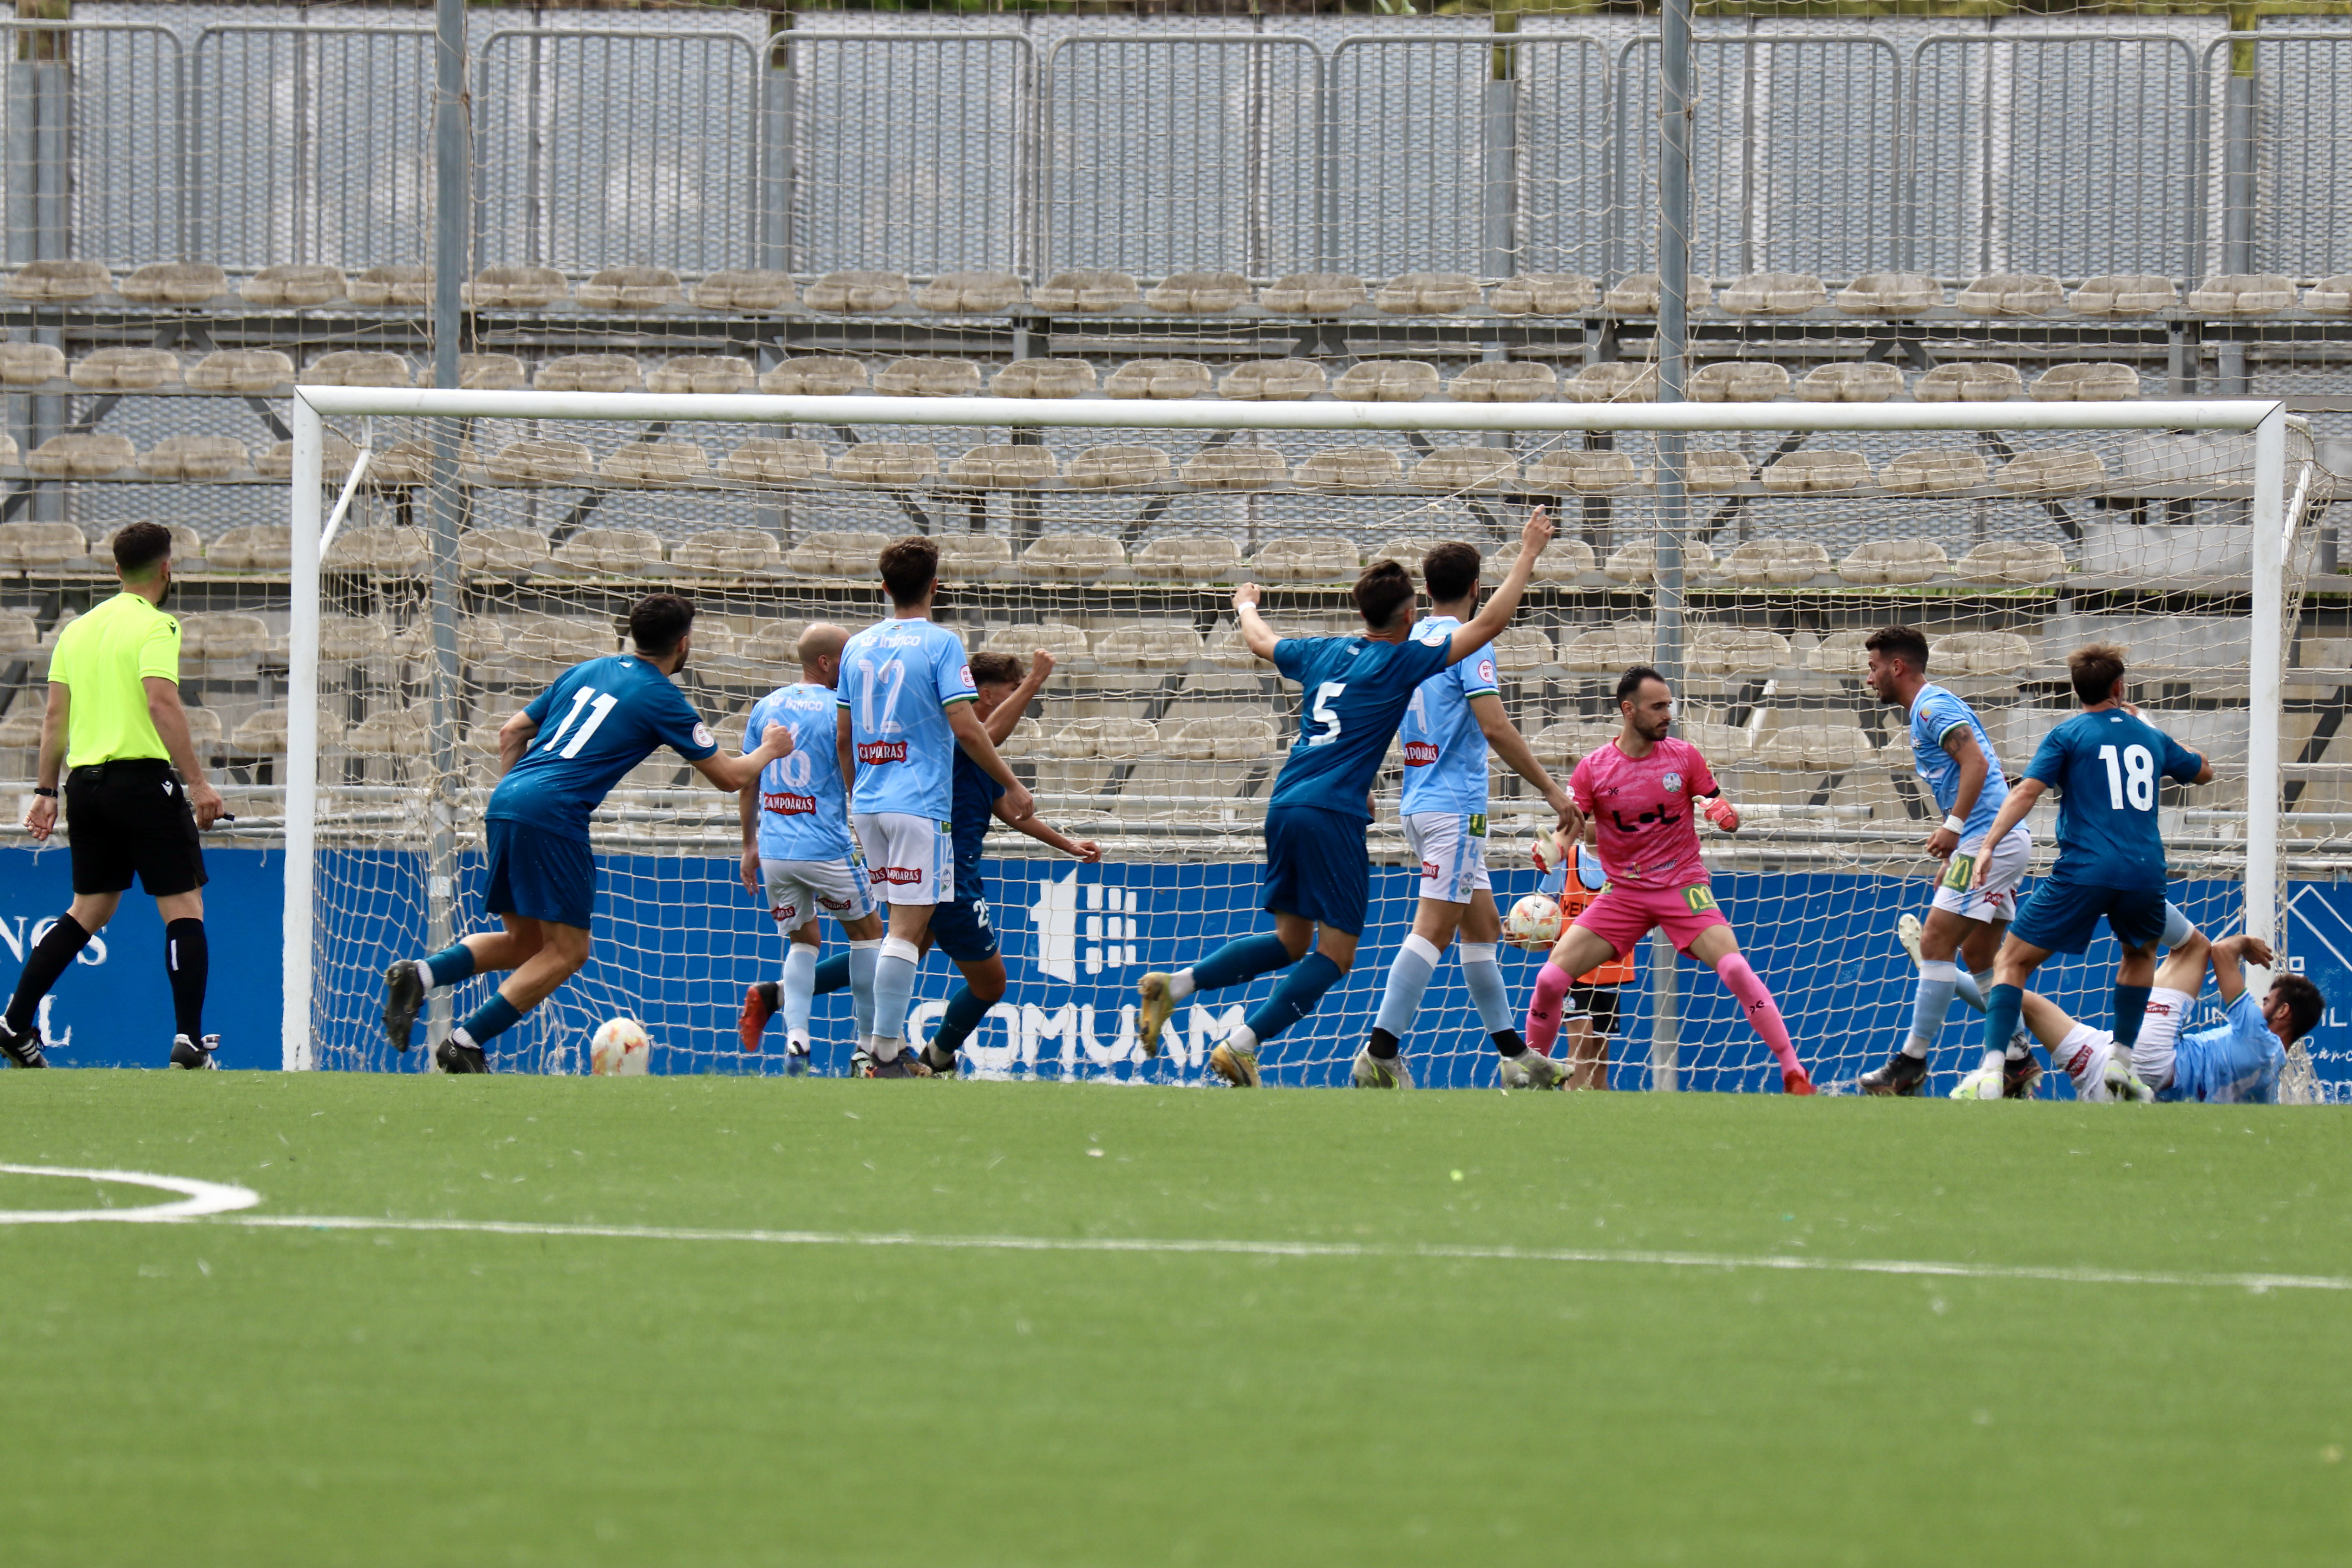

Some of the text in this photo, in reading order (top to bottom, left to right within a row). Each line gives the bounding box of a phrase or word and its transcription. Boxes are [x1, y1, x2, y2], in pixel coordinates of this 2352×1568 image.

[543, 685, 618, 759] 11
[858, 659, 904, 734] 12
[1309, 681, 1347, 746] 5
[765, 796, 813, 811] CAMPOARAS
[2098, 744, 2154, 811] 18
[1468, 838, 1479, 868] 4
